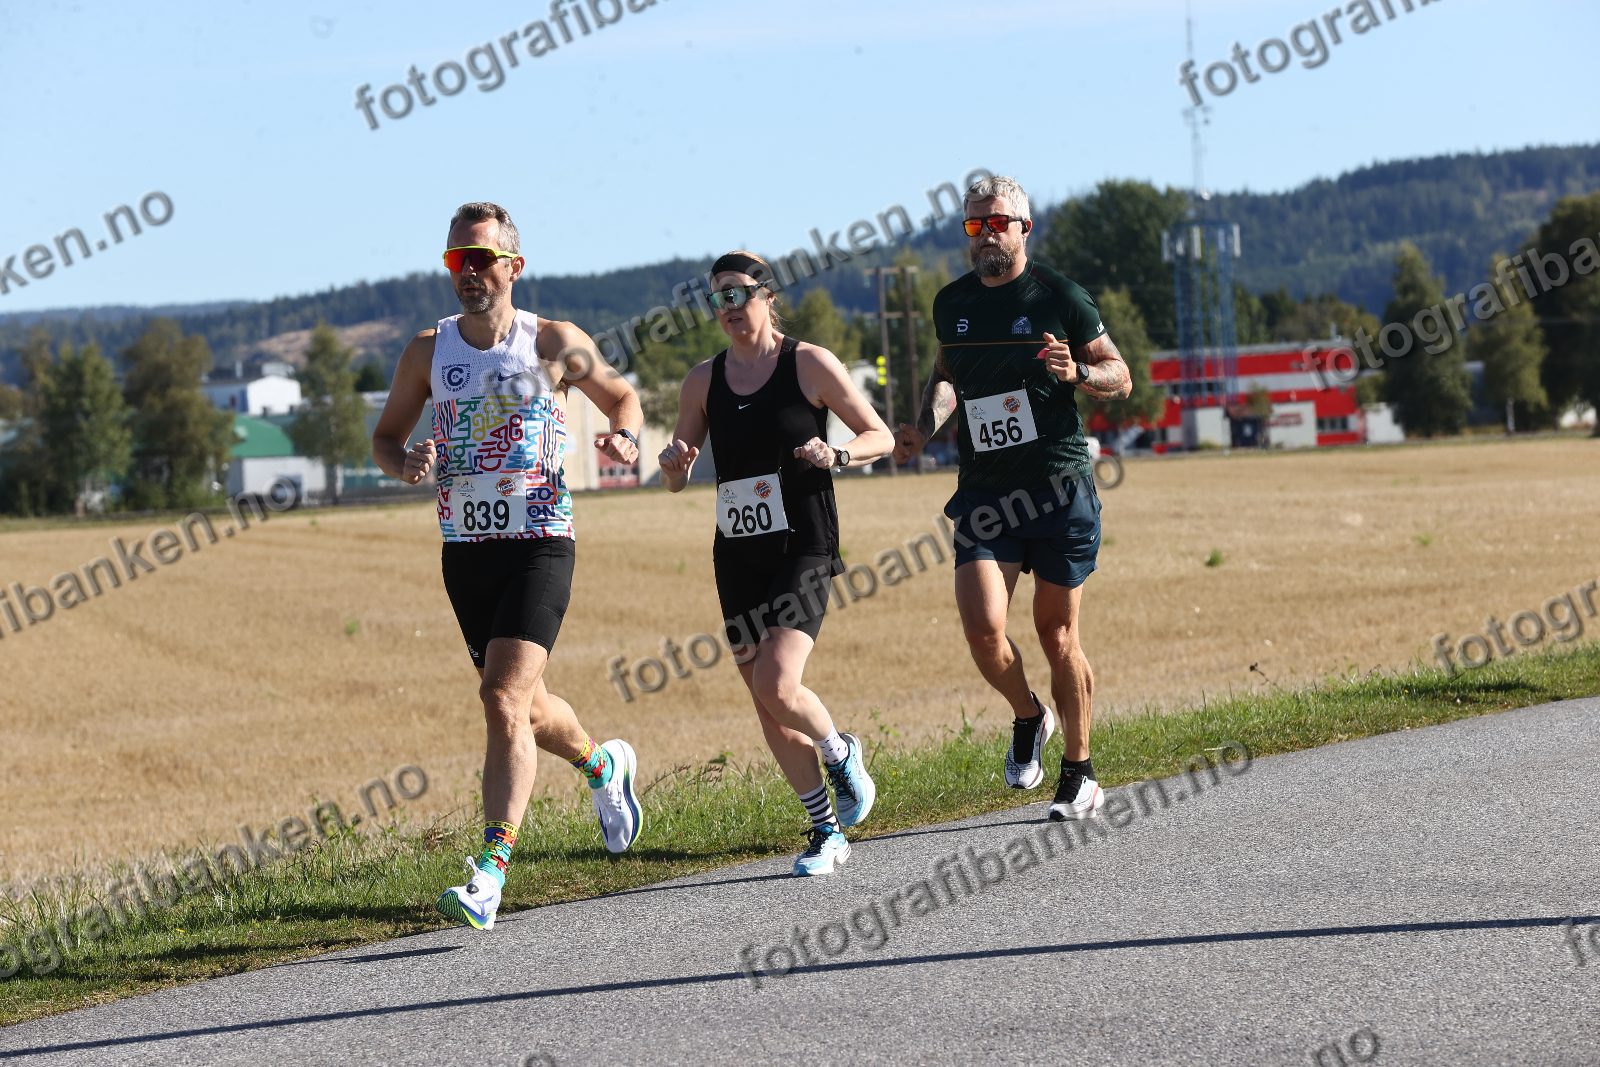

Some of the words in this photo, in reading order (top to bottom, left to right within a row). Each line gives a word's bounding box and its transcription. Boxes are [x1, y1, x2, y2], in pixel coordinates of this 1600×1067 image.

[980, 417, 1023, 448] 456
[463, 500, 509, 531] 839
[728, 502, 772, 535] 260
